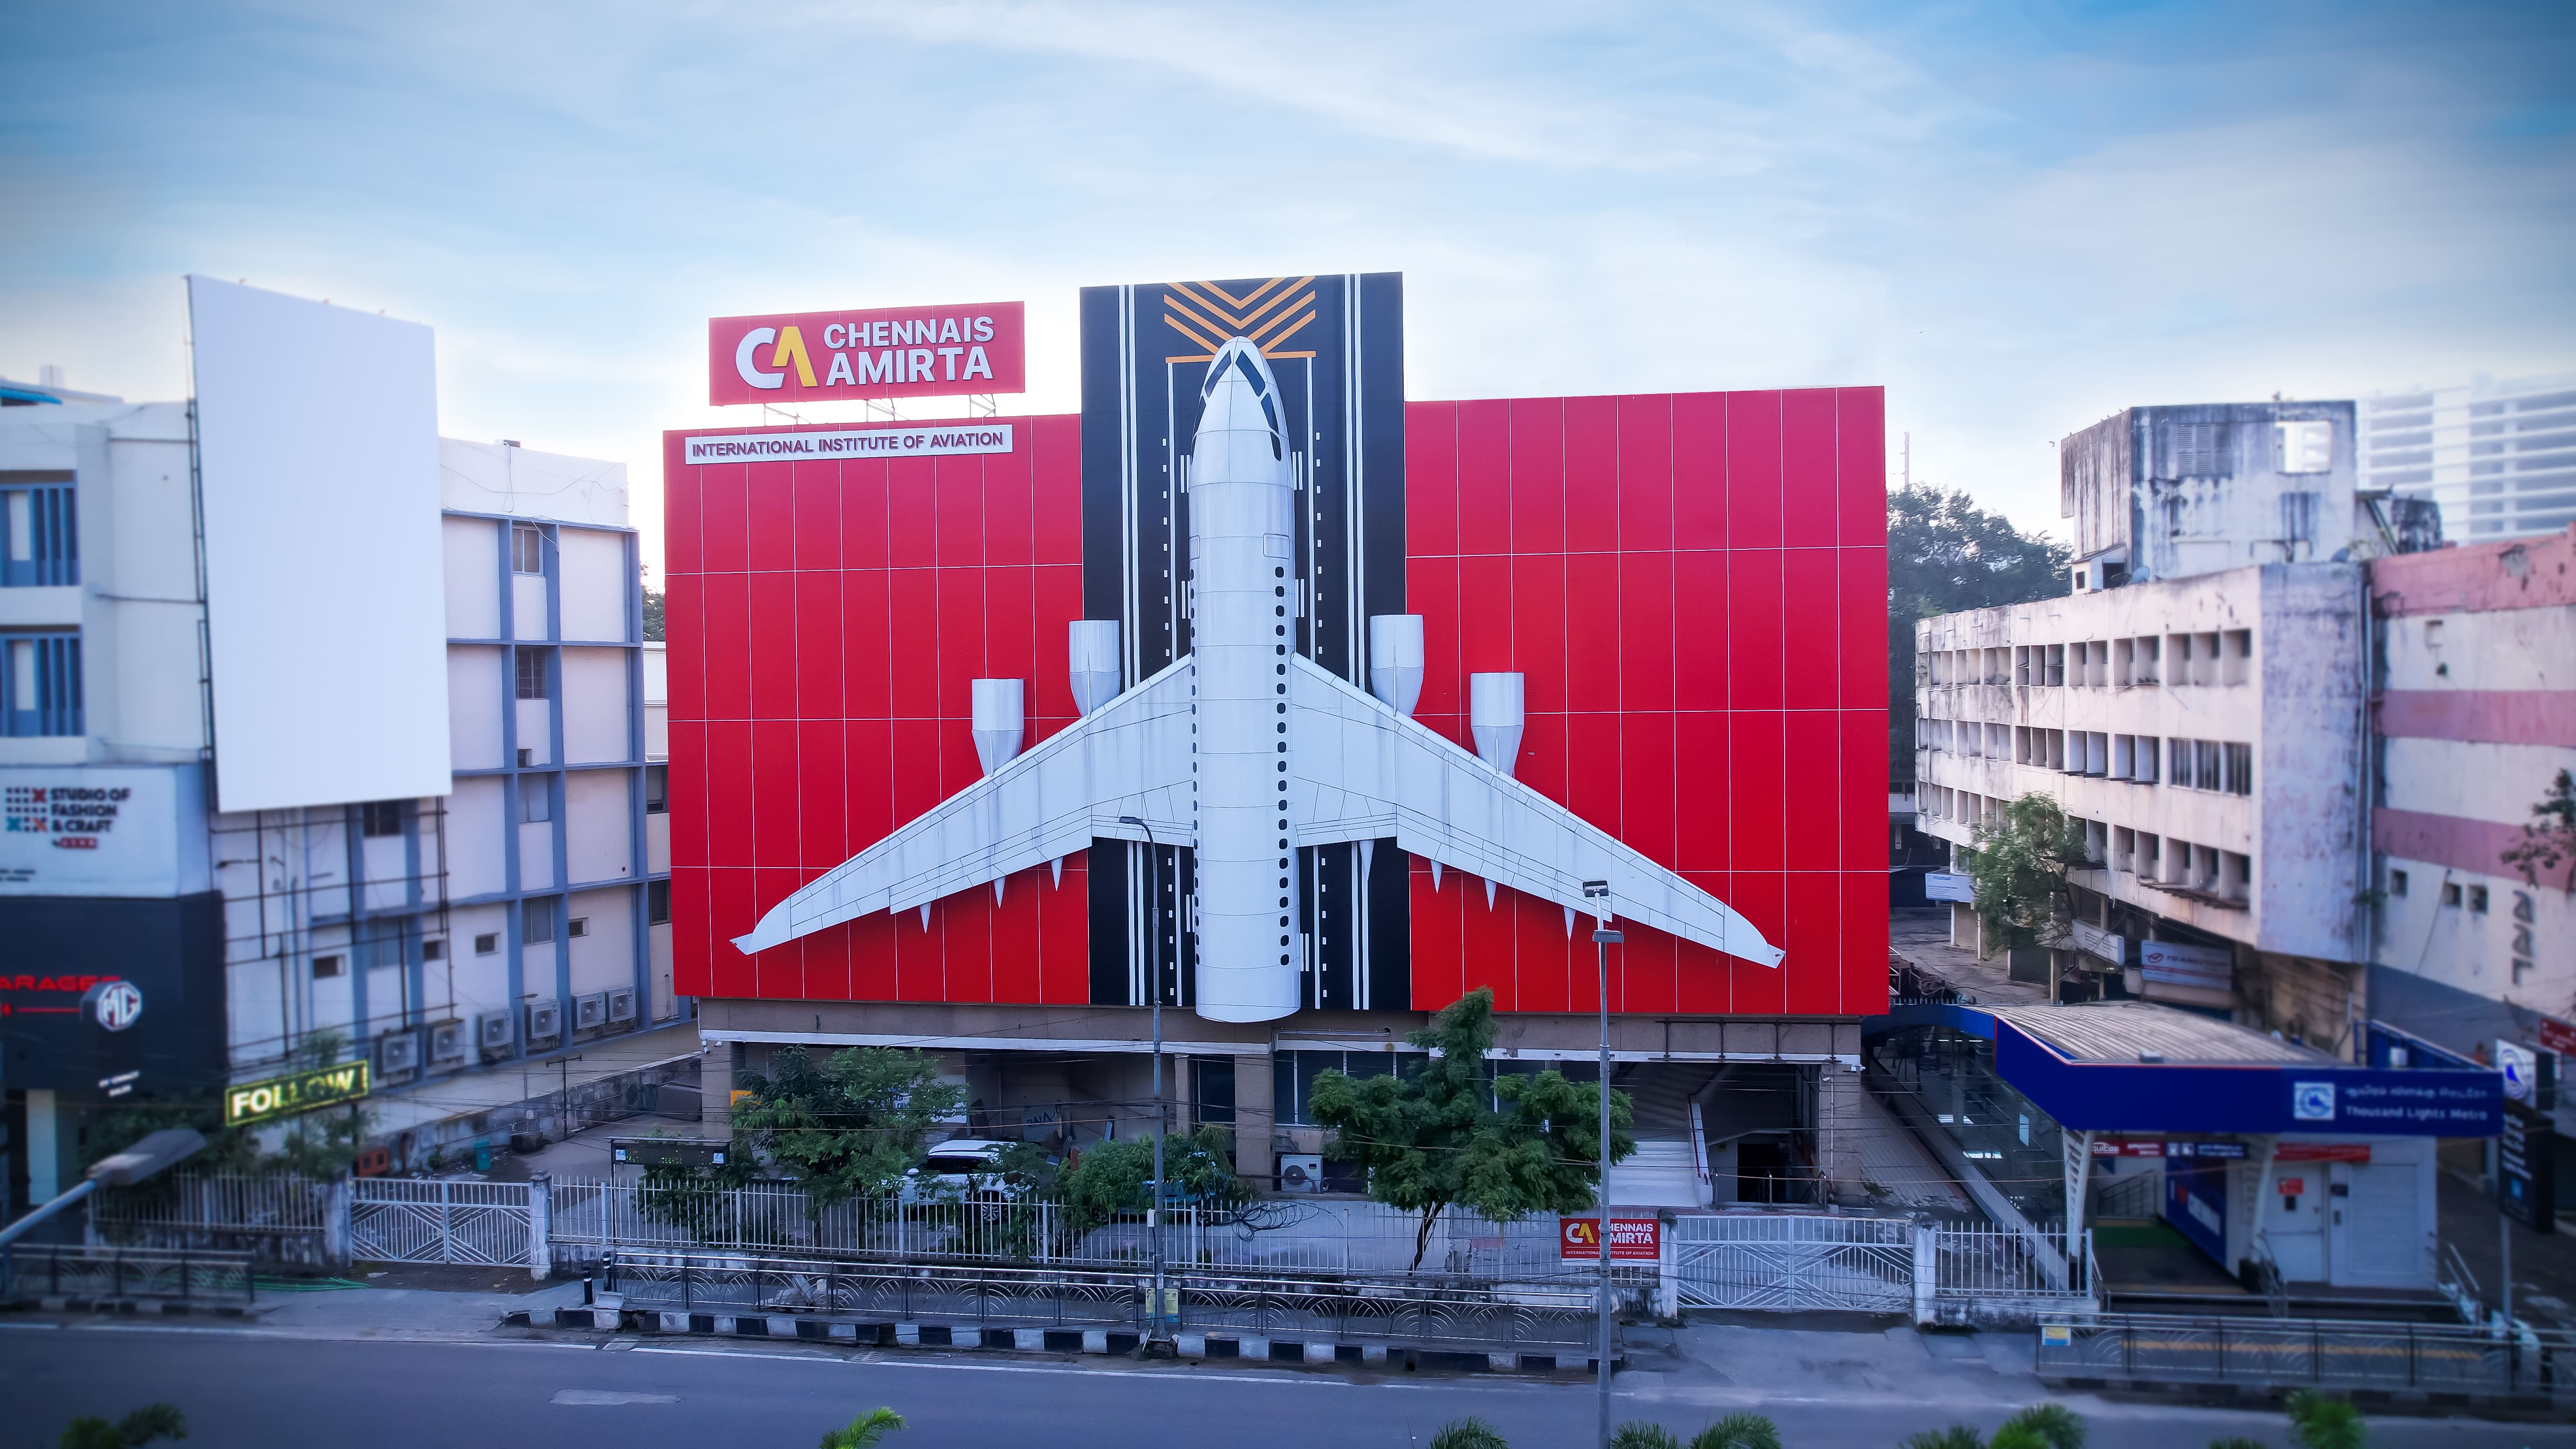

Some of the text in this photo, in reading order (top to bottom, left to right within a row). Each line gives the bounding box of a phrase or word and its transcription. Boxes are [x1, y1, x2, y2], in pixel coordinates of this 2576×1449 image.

[823, 316, 995, 349] CHENNAIS
[826, 346, 994, 387] AMIRTA
[692, 432, 1004, 457] INTERNATIONAL INSTITUTE OF AVIATION
[50, 788, 131, 801] STUDIO OF
[51, 804, 117, 816] FASHION
[65, 819, 112, 832] CRAFT
[0, 975, 121, 991] ARAGE
[102, 987, 139, 1026] MG
[231, 1069, 354, 1118] FOLLOW
[2344, 1105, 2488, 1121] Thousand Lights Metro
[2092, 1143, 2119, 1154] quitas
[1598, 1223, 1653, 1232] HENNAIS
[1599, 1232, 1654, 1244] MIRTA
